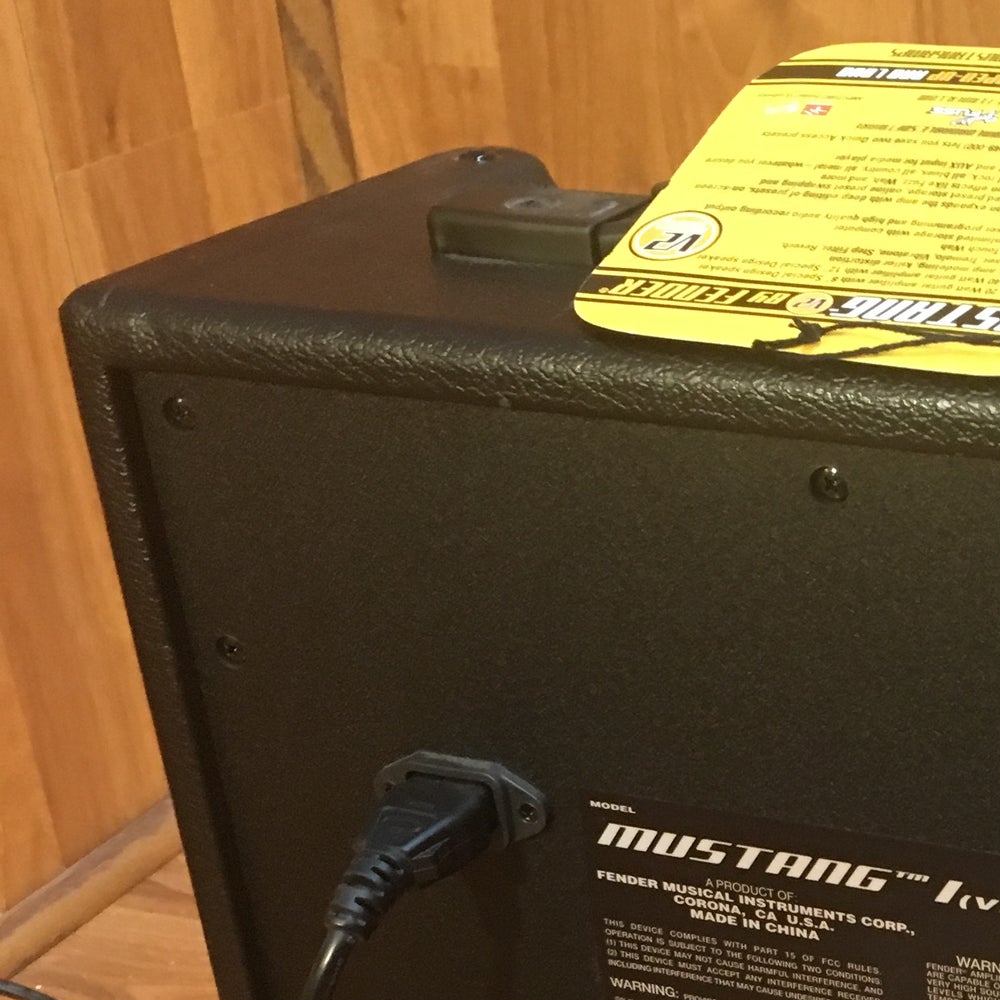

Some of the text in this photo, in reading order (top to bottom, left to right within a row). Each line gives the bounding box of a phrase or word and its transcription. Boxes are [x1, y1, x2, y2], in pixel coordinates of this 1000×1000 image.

[643, 232, 701, 252] V2
[747, 290, 792, 304] BY
[589, 800, 636, 814] MODEL
[597, 869, 658, 889] FENDER
[662, 881, 734, 902] MUSICAL
[738, 894, 856, 924] INSTRUMENTS
[704, 877, 713, 888] A
[716, 879, 773, 898] PRODUCT
[673, 894, 834, 931] CORONA, CA U.S.A.
[690, 908, 819, 940] MADE IN CHINA
[603, 917, 624, 928] THIS
[630, 922, 663, 935] DEVICE
[669, 929, 717, 945] COMPLIES
[723, 939, 747, 950] WITH
[753, 944, 778, 956] PART
[785, 950, 796, 959] 15
[801, 953, 814, 963] OF
[821, 957, 840, 968] FCC
[604, 927, 653, 943] OPERATION
[656, 937, 665, 945] IS
[668, 939, 706, 953] SUBJECT
[710, 947, 722, 956] TO
[726, 950, 742, 959] THE
[746, 954, 798, 970] FOLLOWING
[802, 964, 822, 974] TWO
[609, 975, 679, 1000] WARNING:
